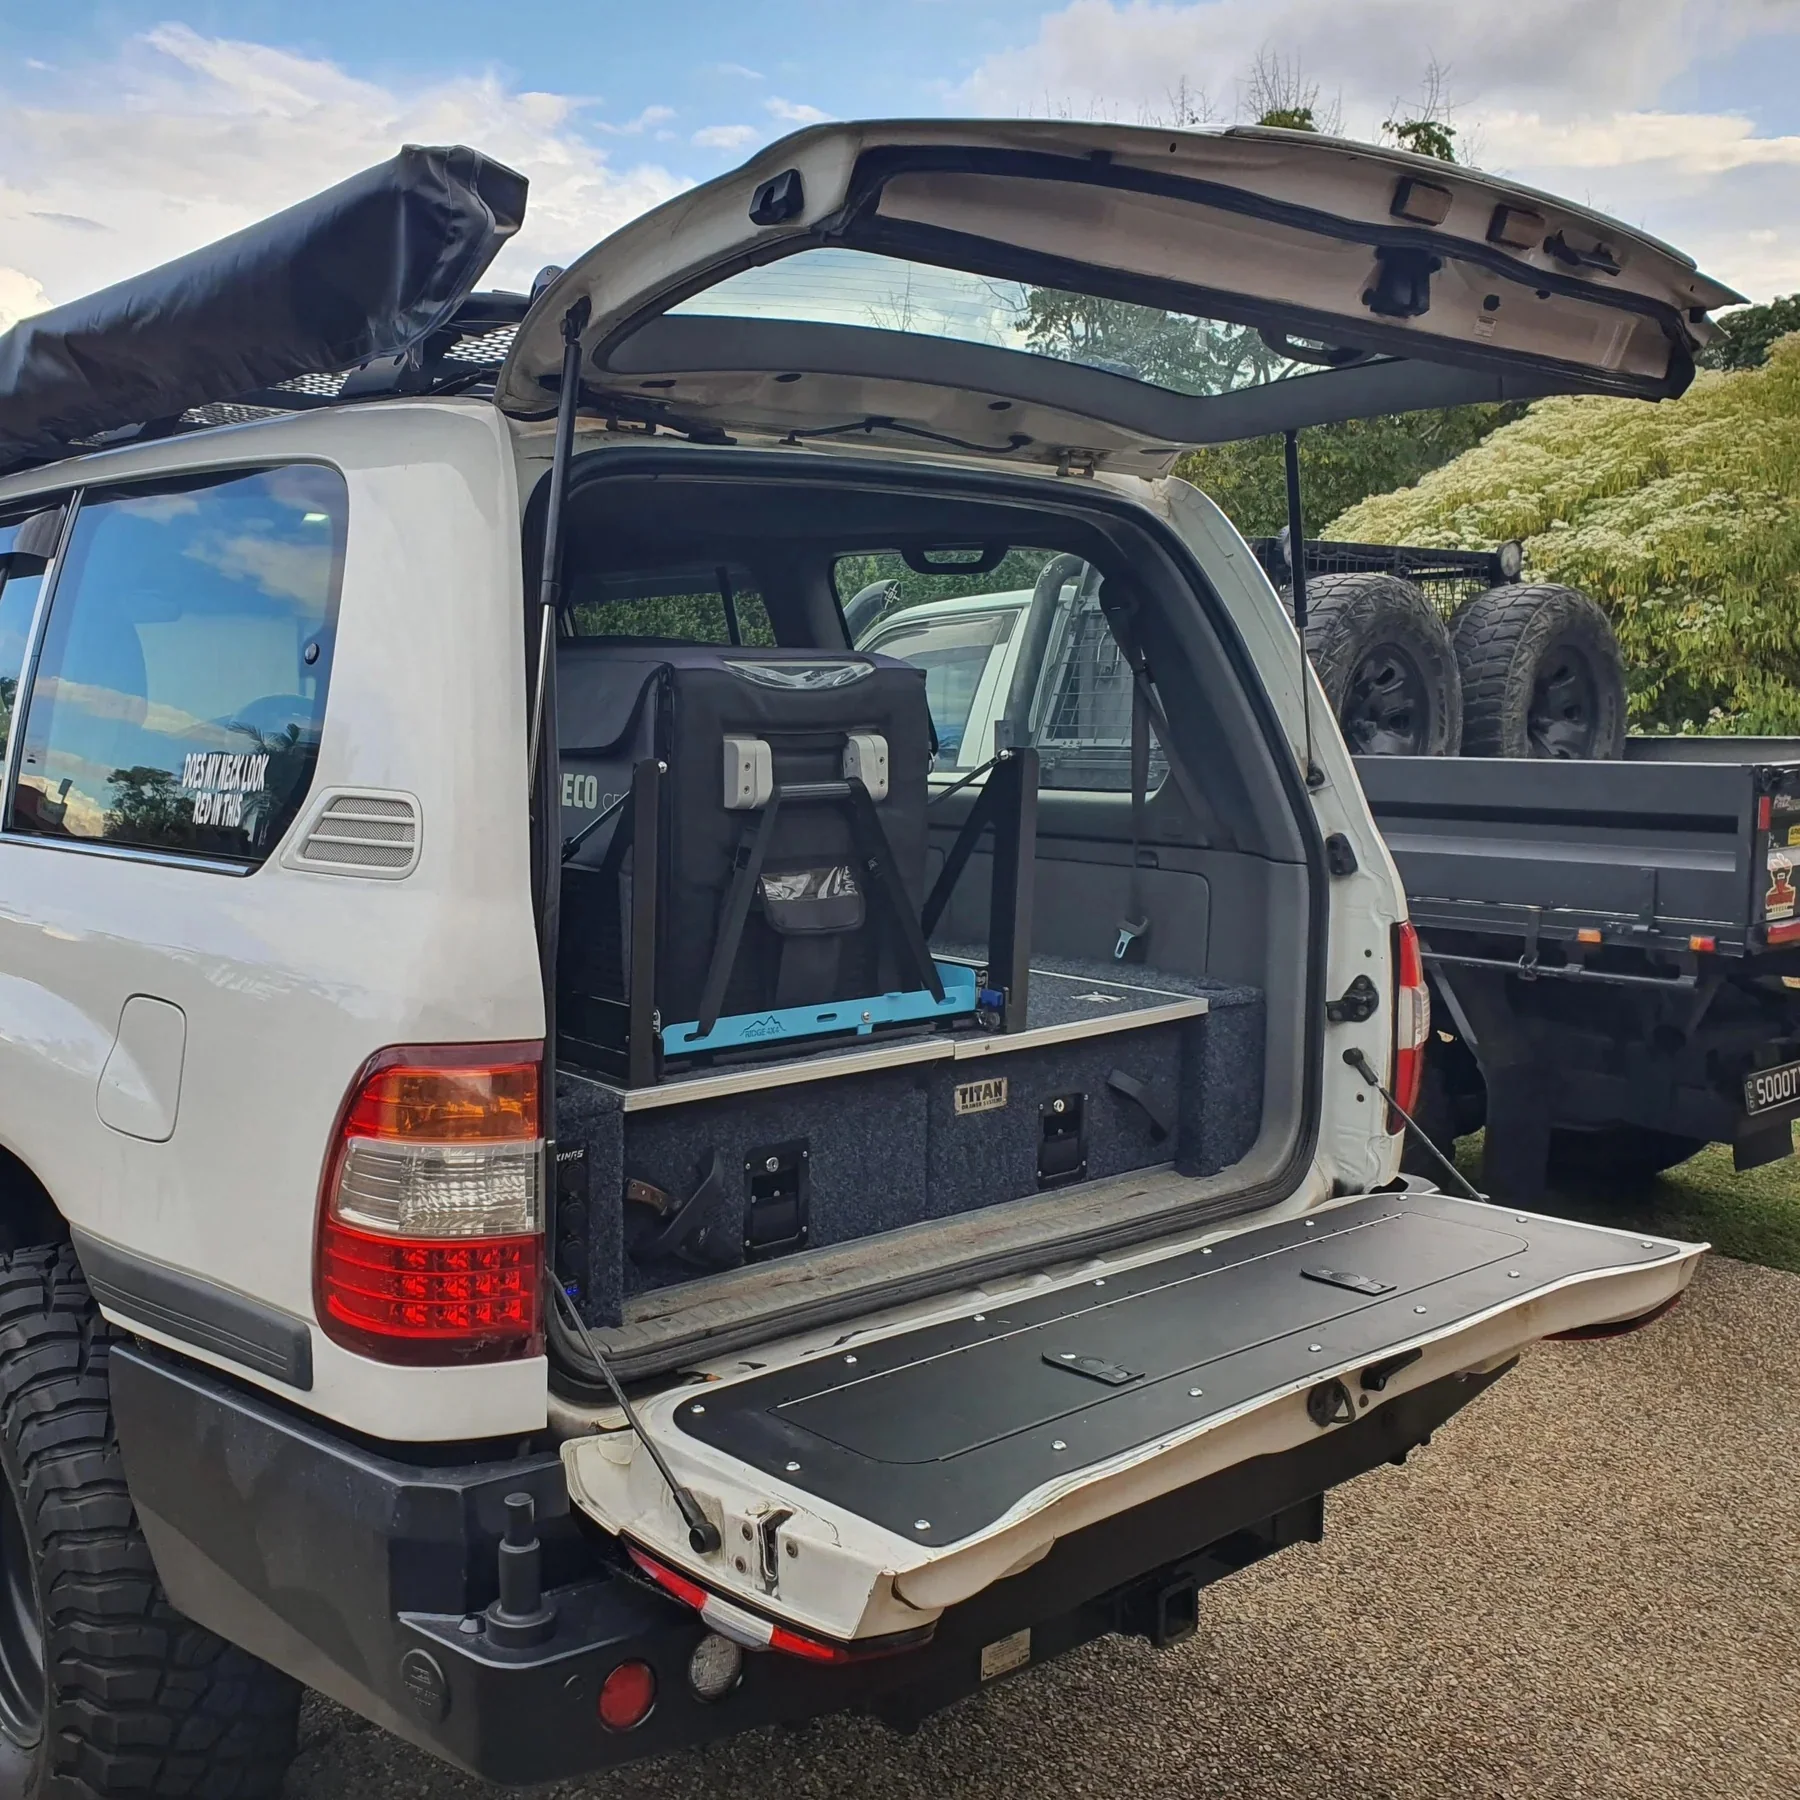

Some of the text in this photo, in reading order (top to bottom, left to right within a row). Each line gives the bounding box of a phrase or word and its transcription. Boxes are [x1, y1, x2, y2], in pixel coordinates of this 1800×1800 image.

[182, 752, 270, 792] DOES MY NECK LOOK
[192, 791, 243, 827] RED IN THIS
[560, 773, 598, 809] ECO
[960, 1080, 1003, 1104] TITAN
[1756, 1066, 1800, 1105] SOOOT
